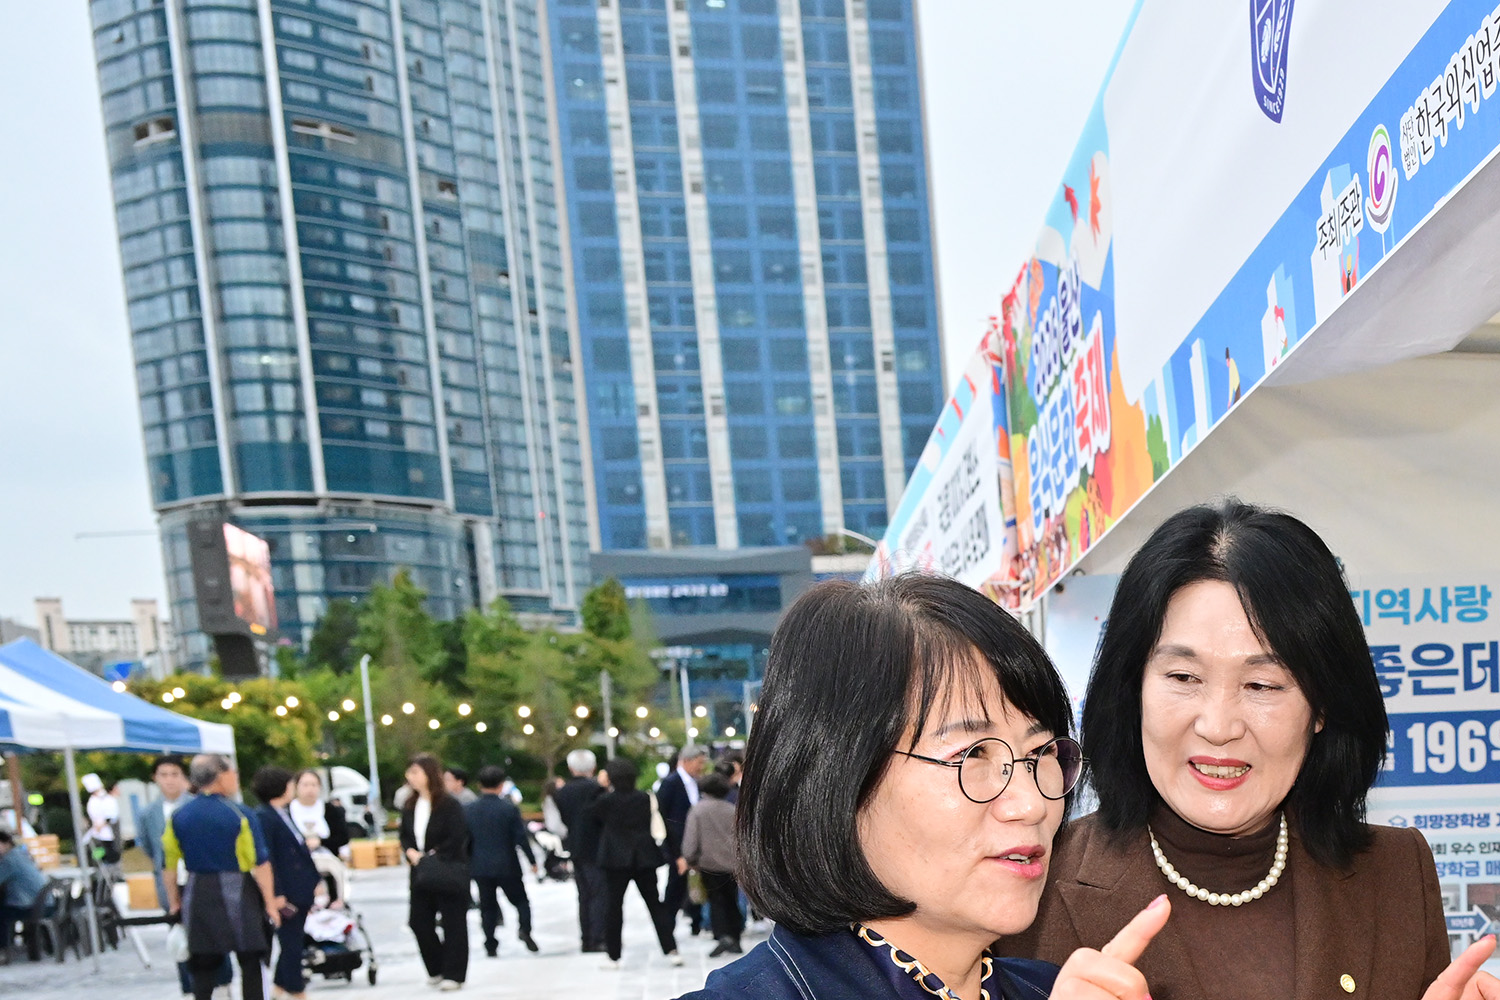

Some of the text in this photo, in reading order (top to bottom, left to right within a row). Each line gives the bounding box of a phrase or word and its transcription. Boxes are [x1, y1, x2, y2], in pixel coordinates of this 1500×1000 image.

[1319, 182, 1362, 261] 주최/주관
[1413, 811, 1491, 829] 희망장학생
[1450, 842, 1476, 855] 우수
[1435, 859, 1480, 877] 장학금
